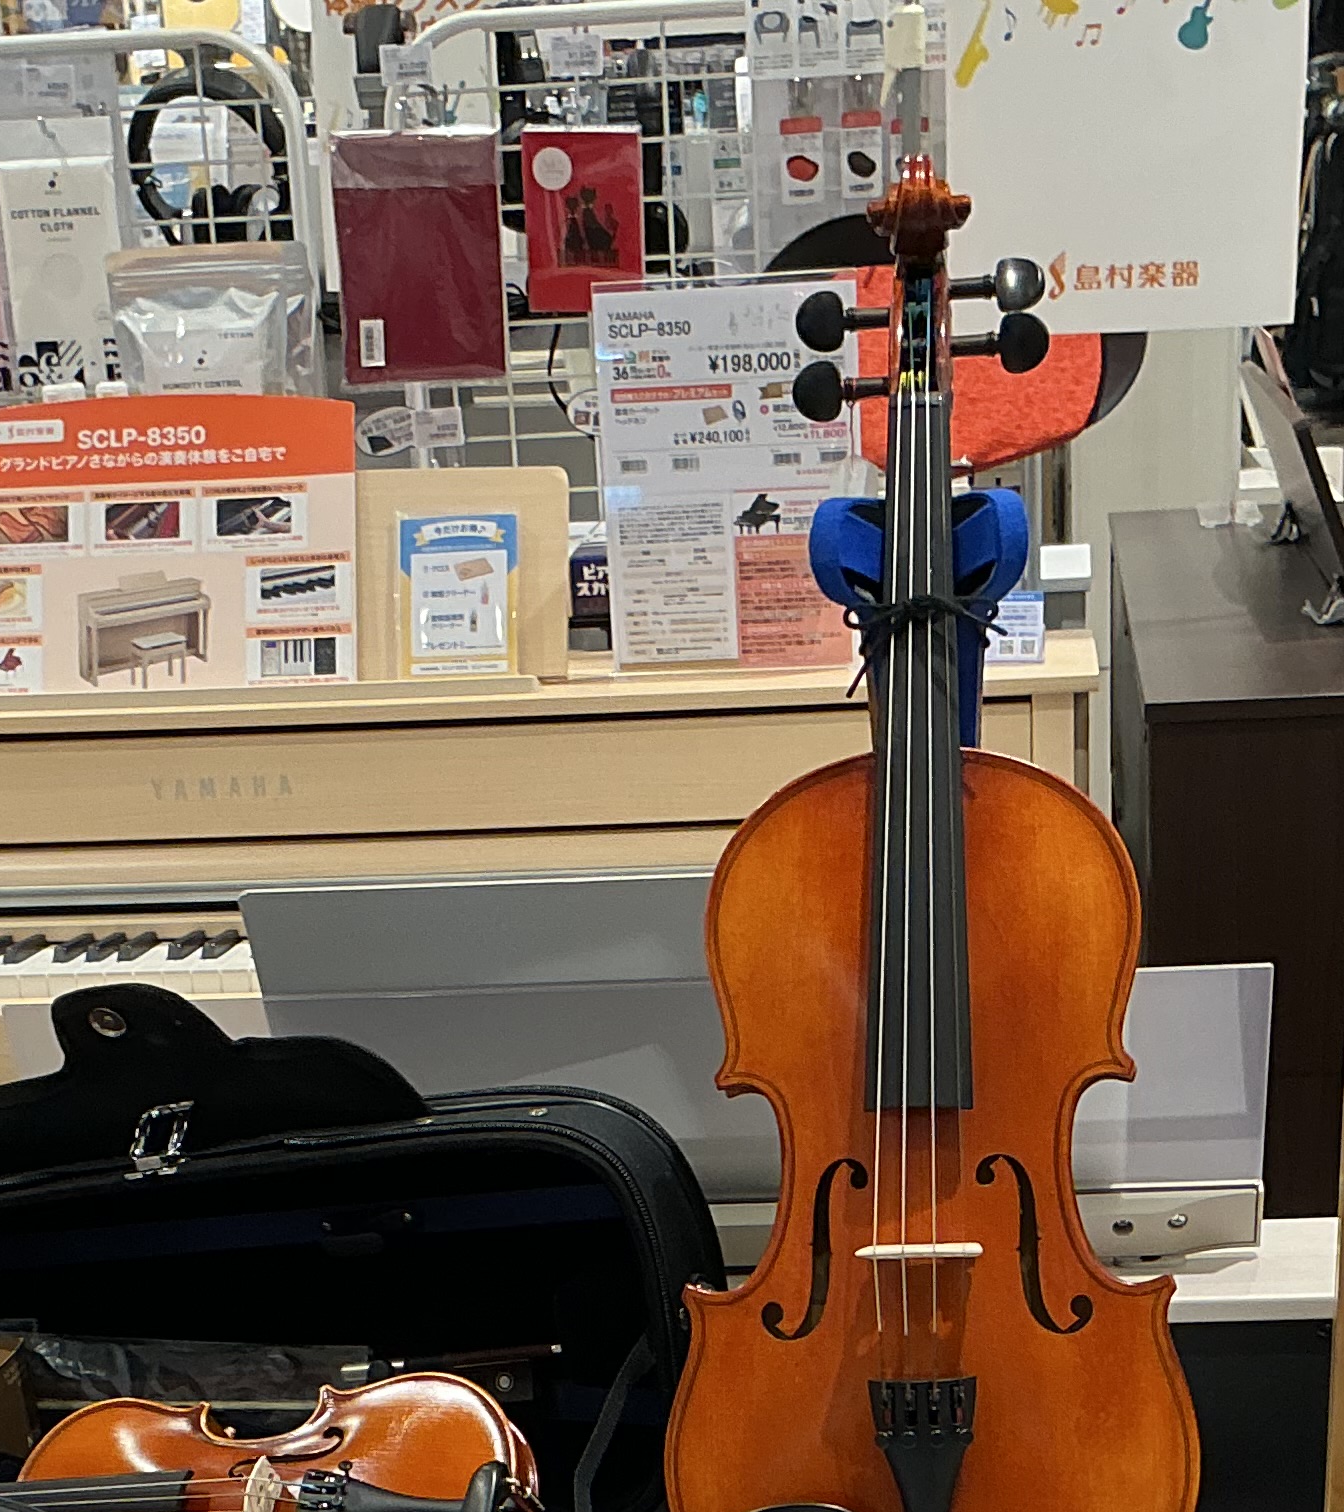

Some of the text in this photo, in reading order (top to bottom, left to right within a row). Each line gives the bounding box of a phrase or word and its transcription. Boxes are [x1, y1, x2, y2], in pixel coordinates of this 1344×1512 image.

[1073, 260, 1200, 291] 島村楽器
[608, 321, 691, 339] SCLP-8350
[708, 351, 791, 373] ¥198,000
[77, 425, 206, 449] SCLP-8350
[0, 447, 286, 473] グランドピアノさながらの演奏体験をご自宅で
[151, 774, 292, 801] YAMAHA
